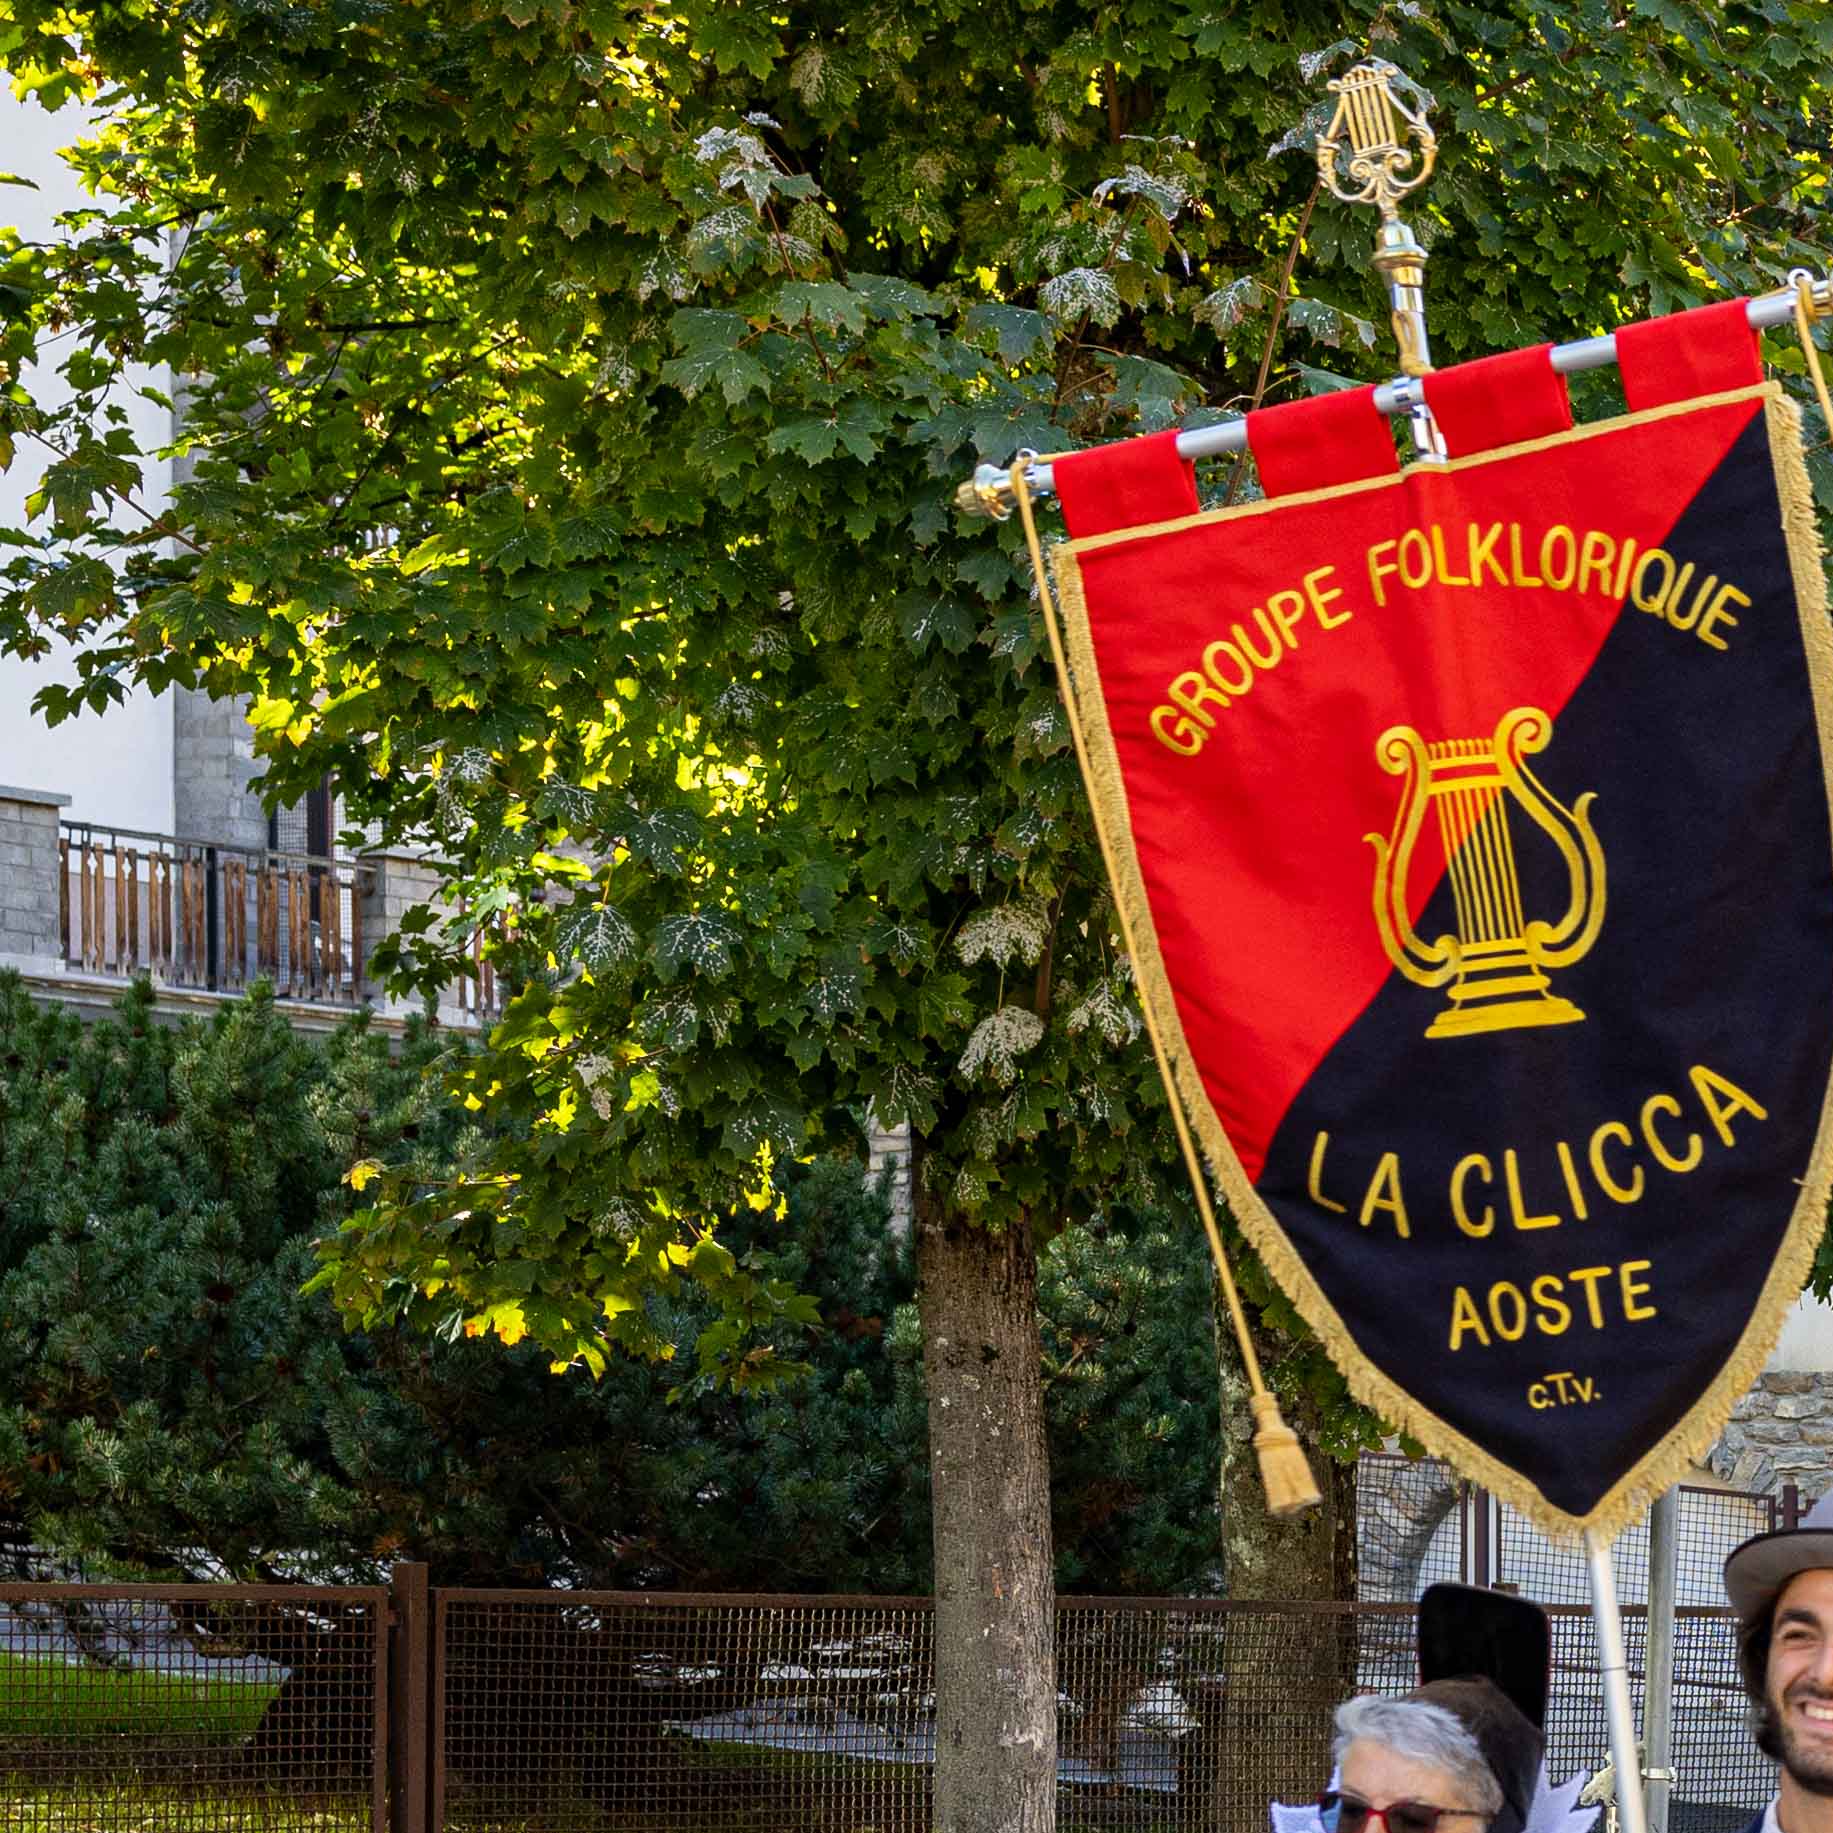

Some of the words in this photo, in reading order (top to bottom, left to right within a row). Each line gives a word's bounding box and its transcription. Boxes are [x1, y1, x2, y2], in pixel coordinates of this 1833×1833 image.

[1149, 564, 1352, 757] GROUPE
[1367, 522, 1753, 652] FOLKLORIQUE
[1307, 1130, 1411, 1239] LA
[1448, 1063, 1769, 1239] CLICCA
[1448, 1259, 1657, 1352] AOSTE
